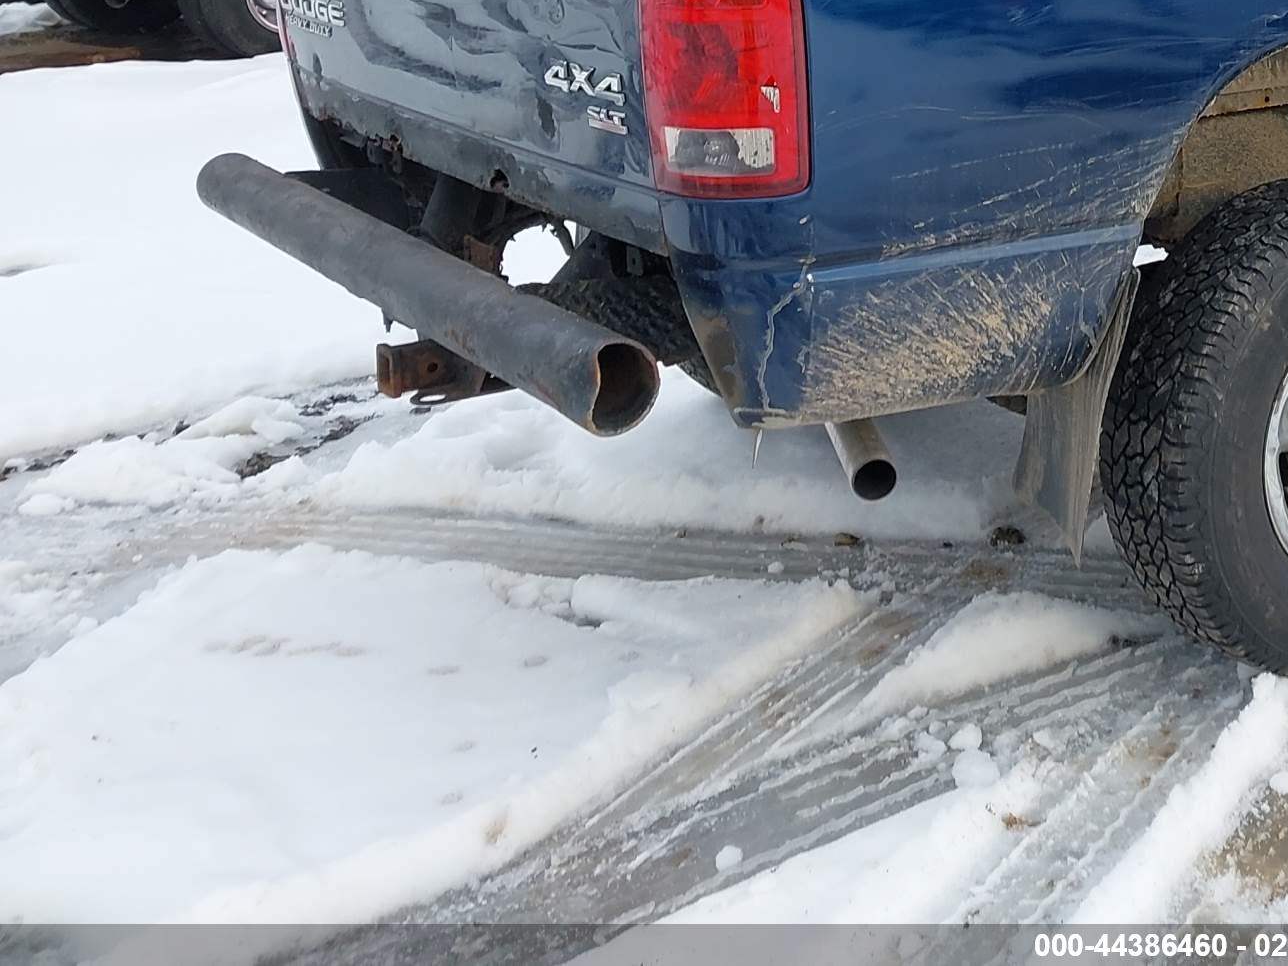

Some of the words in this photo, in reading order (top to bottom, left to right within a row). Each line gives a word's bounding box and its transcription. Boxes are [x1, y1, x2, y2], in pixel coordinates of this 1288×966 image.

[309, 22, 332, 37] DUTY
[544, 60, 625, 106] 4X4
[587, 105, 627, 130] SLT
